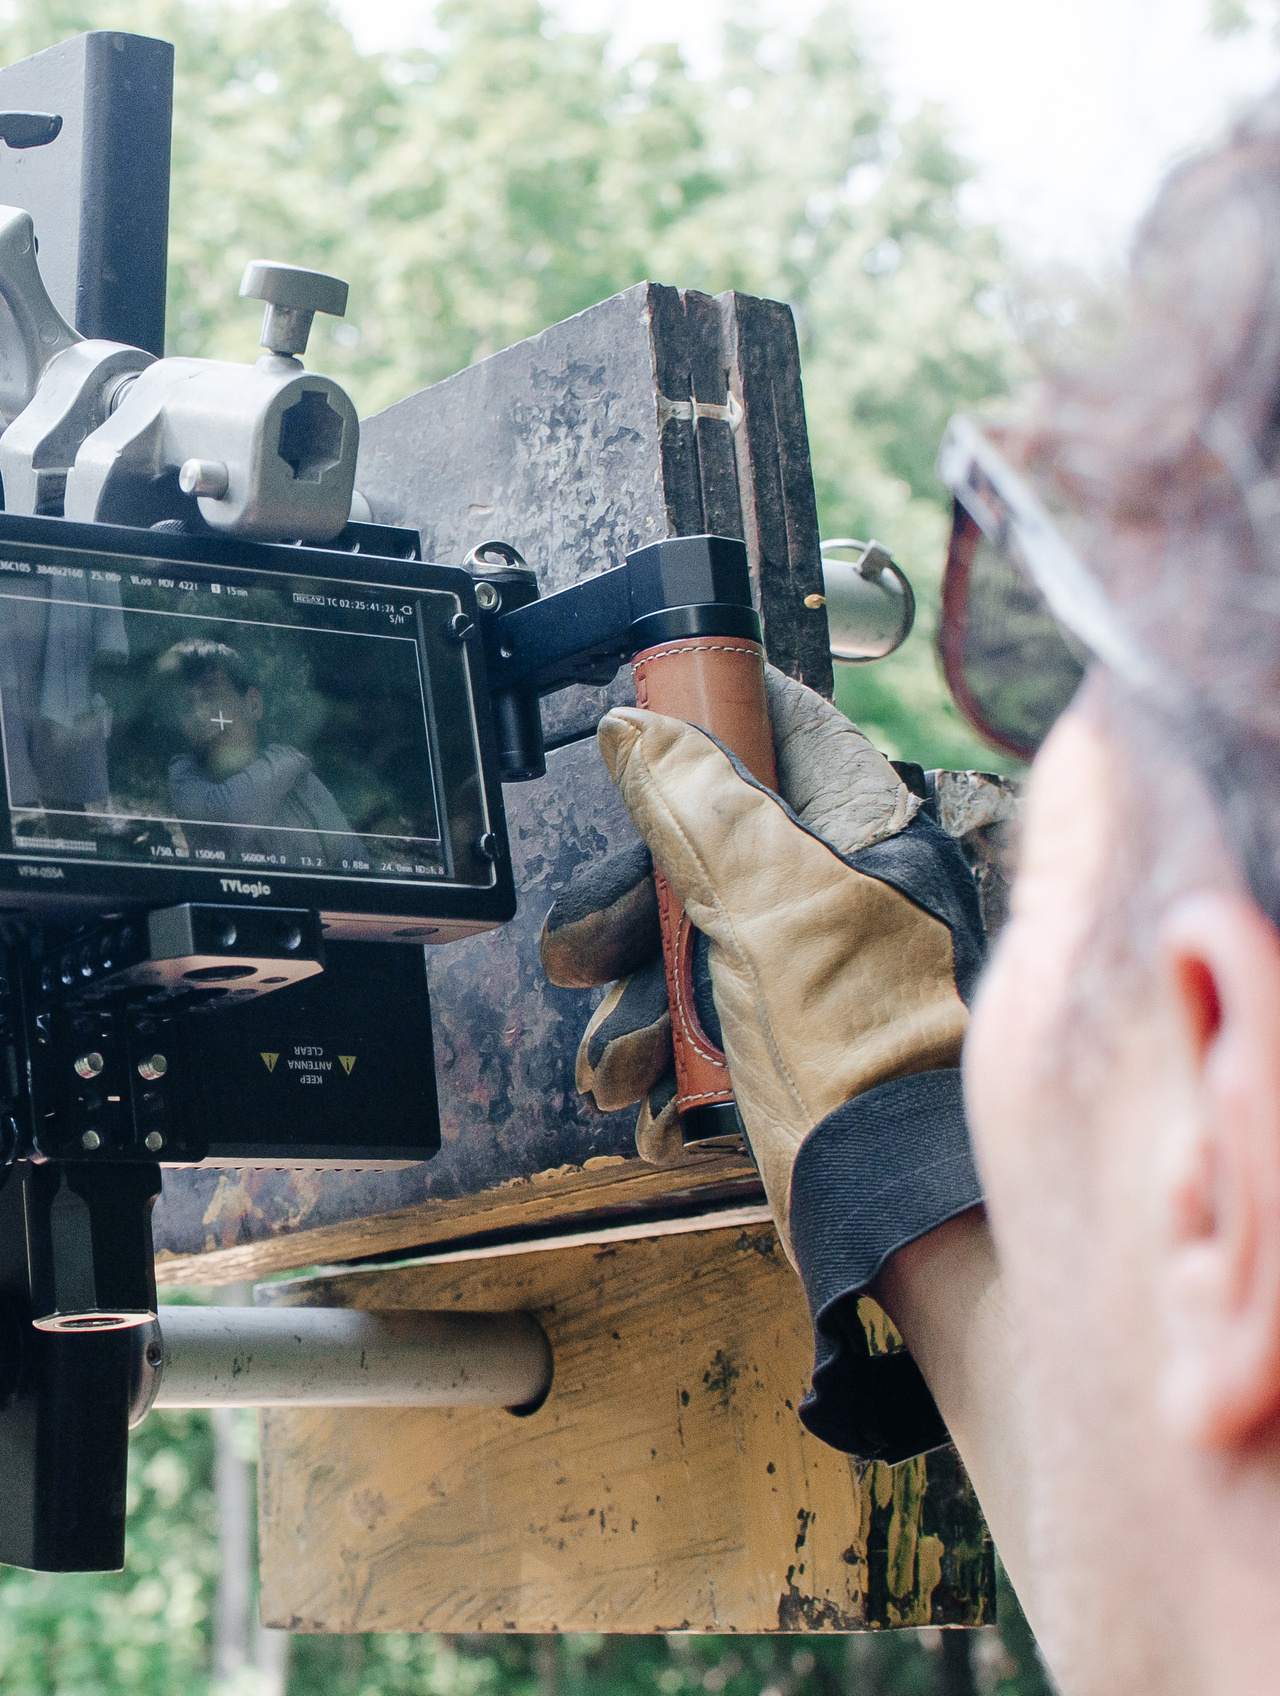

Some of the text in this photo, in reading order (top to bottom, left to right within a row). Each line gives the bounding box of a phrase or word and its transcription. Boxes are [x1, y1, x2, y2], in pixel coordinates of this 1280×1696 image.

[328, 598, 338, 607] TC
[339, 599, 395, 613] 02:25:41:24
[294, 1046, 324, 1056] CLEAR
[287, 1060, 332, 1071] ANTENNA
[299, 1074, 323, 1084] KEEP
